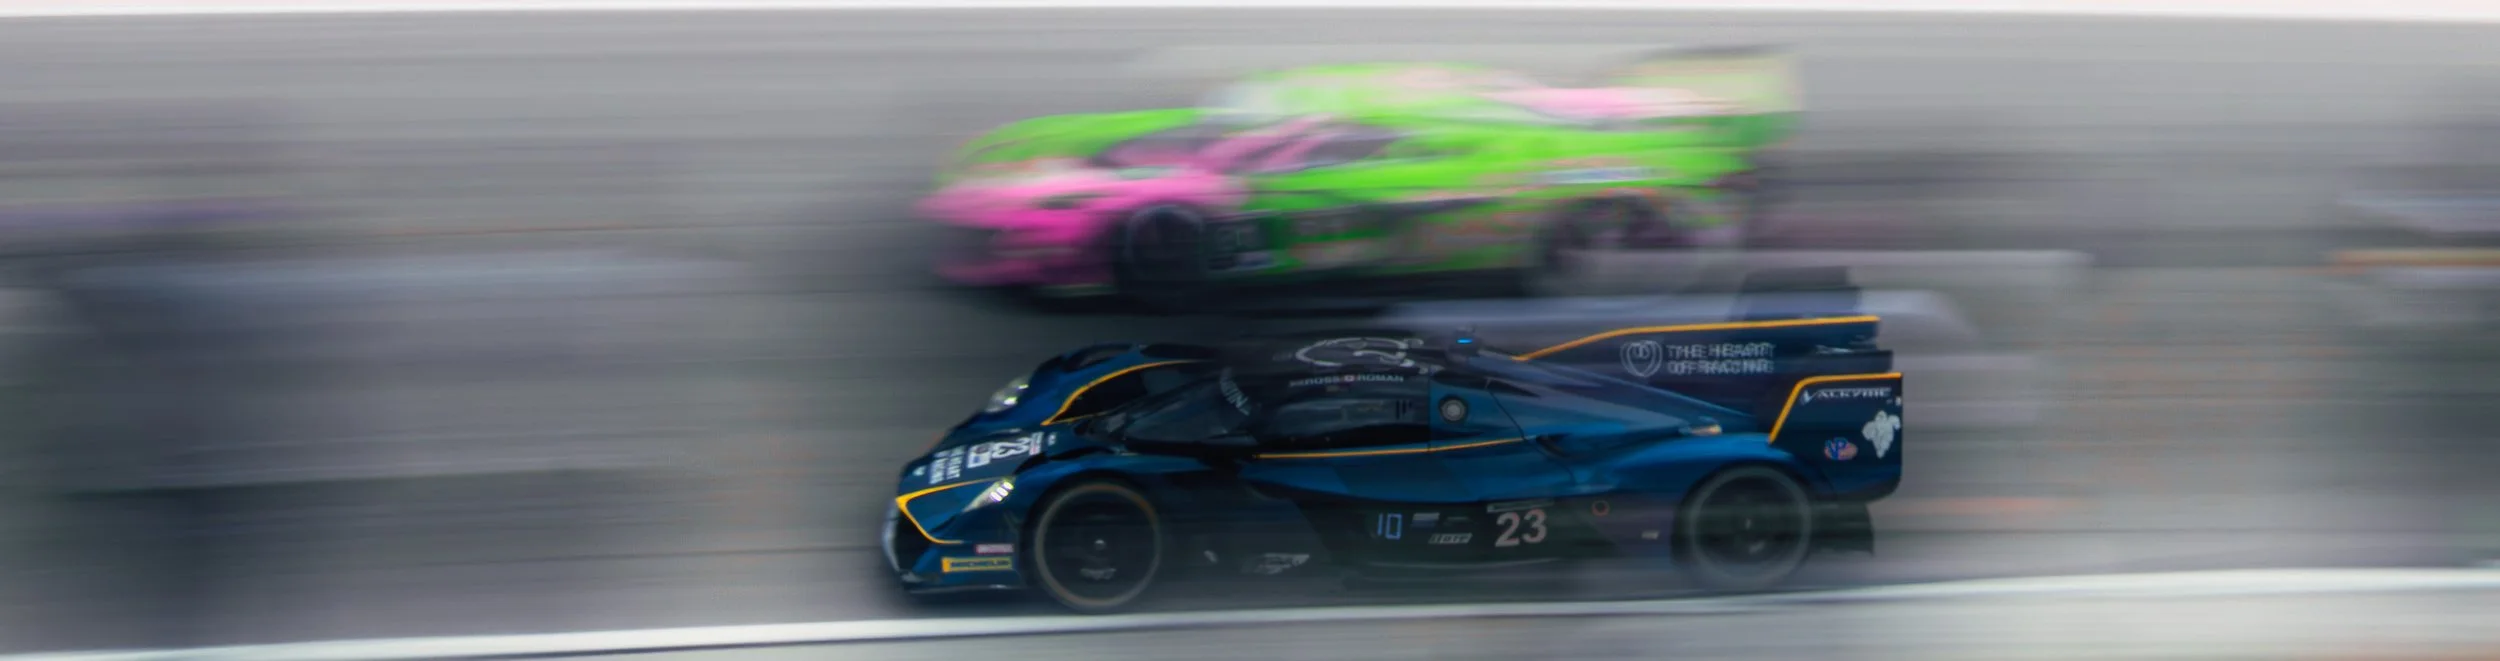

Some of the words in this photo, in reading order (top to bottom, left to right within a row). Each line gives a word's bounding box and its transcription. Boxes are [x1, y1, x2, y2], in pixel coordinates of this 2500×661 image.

[1666, 344, 1706, 358] THE
[1707, 342, 1775, 357] HEART
[1667, 360, 1698, 375] OF
[1697, 358, 1776, 374] RACING
[1376, 513, 1402, 540] 10
[1494, 508, 1548, 547] 23
